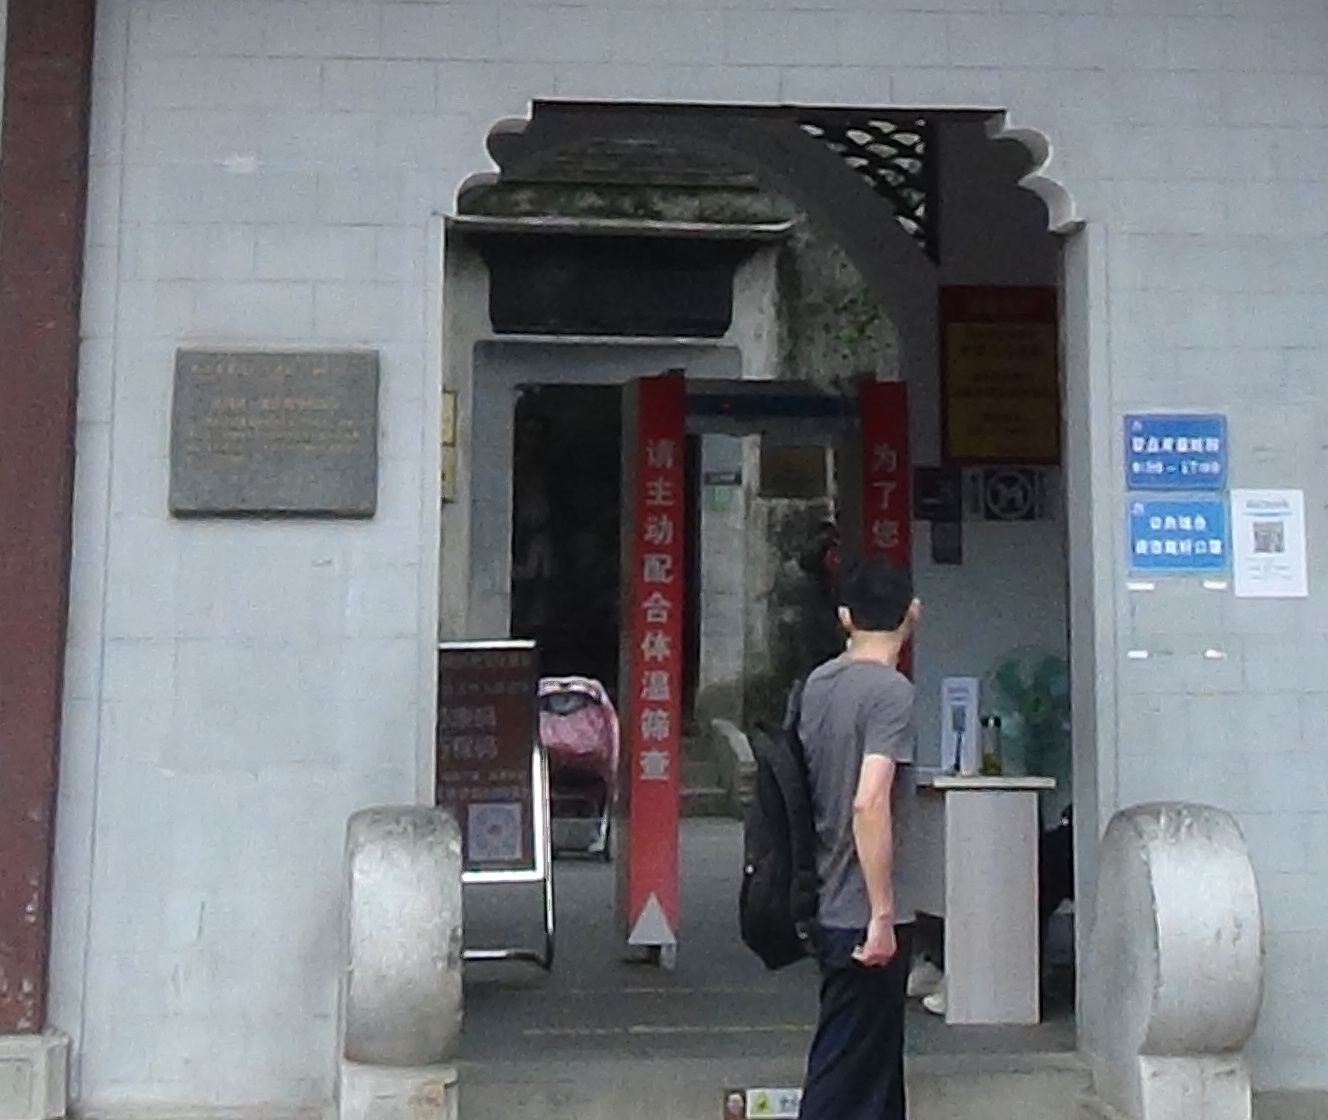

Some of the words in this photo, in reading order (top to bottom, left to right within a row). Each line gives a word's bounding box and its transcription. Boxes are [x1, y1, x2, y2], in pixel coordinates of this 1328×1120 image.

[871, 441, 900, 548] 为了您
[639, 438, 676, 782] 请主动配合体温筛查
